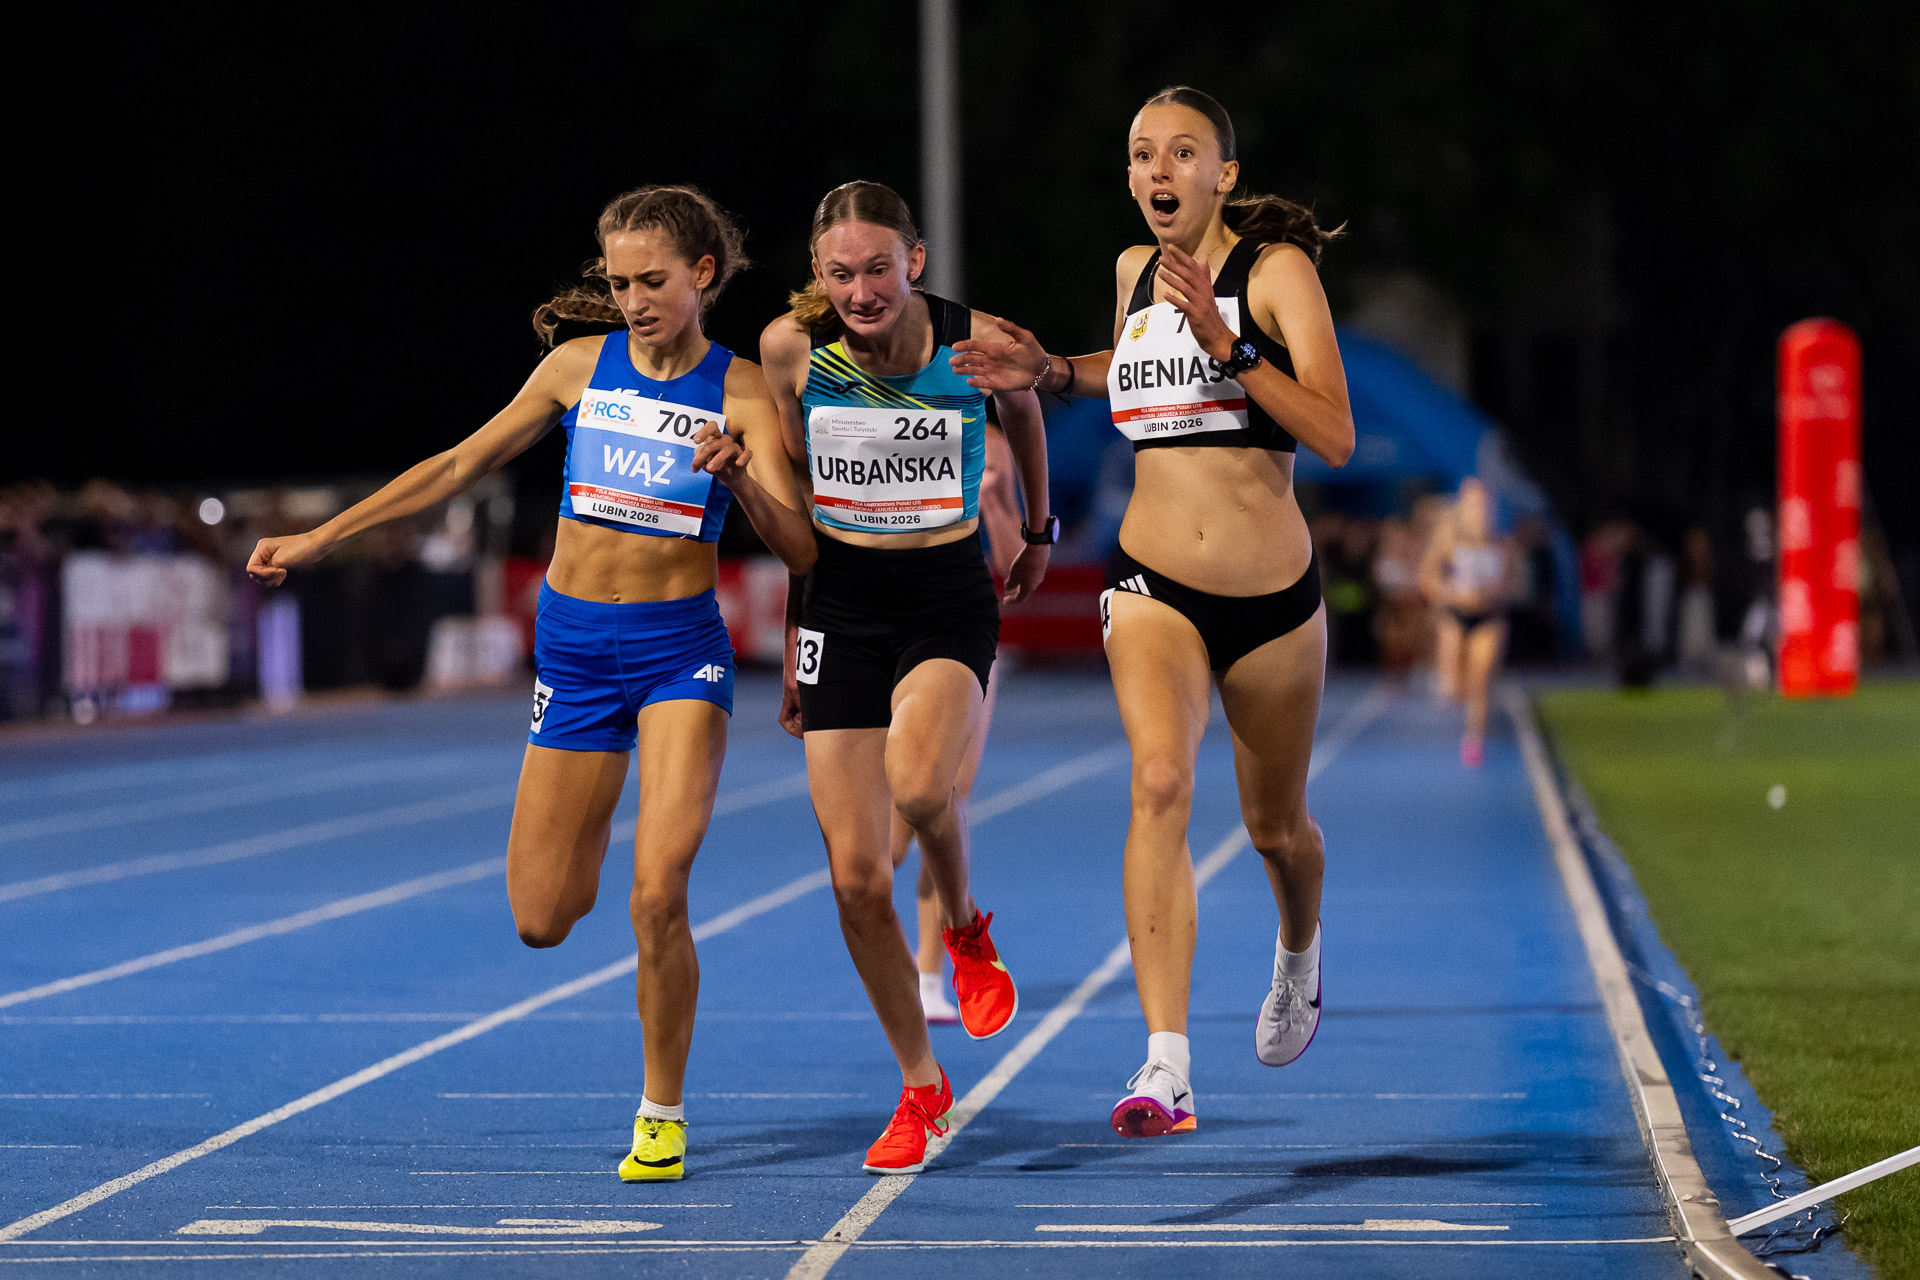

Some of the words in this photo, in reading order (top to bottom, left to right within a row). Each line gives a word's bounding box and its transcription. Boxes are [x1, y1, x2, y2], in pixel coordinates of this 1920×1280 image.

[893, 416, 948, 441] 264
[1144, 422, 1168, 433] LUBIN
[1171, 418, 1203, 430] 2026
[603, 444, 676, 487] WĄŻ
[817, 453, 956, 486] URBAŃSKA
[592, 503, 627, 518] LUBIN
[630, 510, 659, 523] 2026
[853, 513, 888, 525] LUBIN
[890, 515, 921, 524] 2026
[1101, 596, 1110, 630] 4
[796, 635, 819, 675] 13
